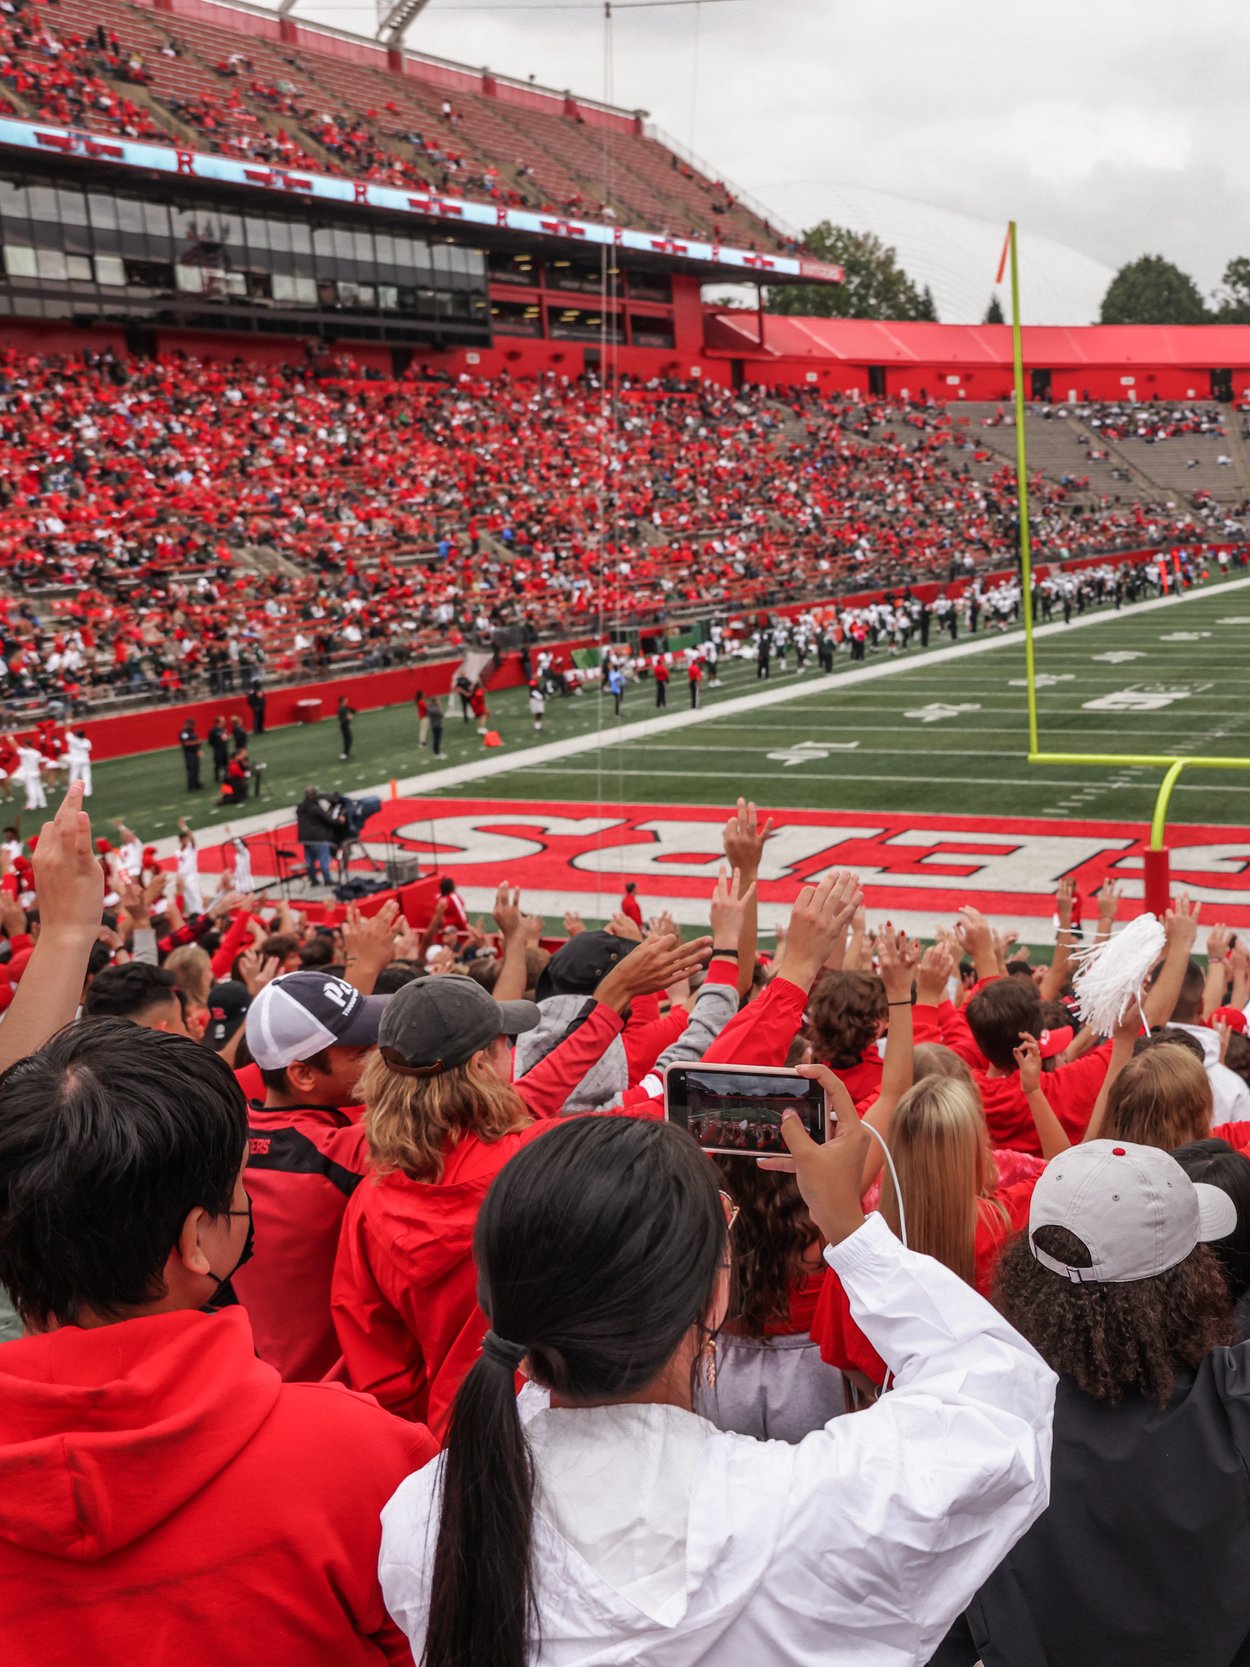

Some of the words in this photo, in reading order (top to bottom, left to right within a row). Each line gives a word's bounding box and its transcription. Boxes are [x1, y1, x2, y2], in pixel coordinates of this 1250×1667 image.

[175, 151, 200, 175] R
[353, 182, 371, 205] R
[248, 1138, 272, 1155] ERS
